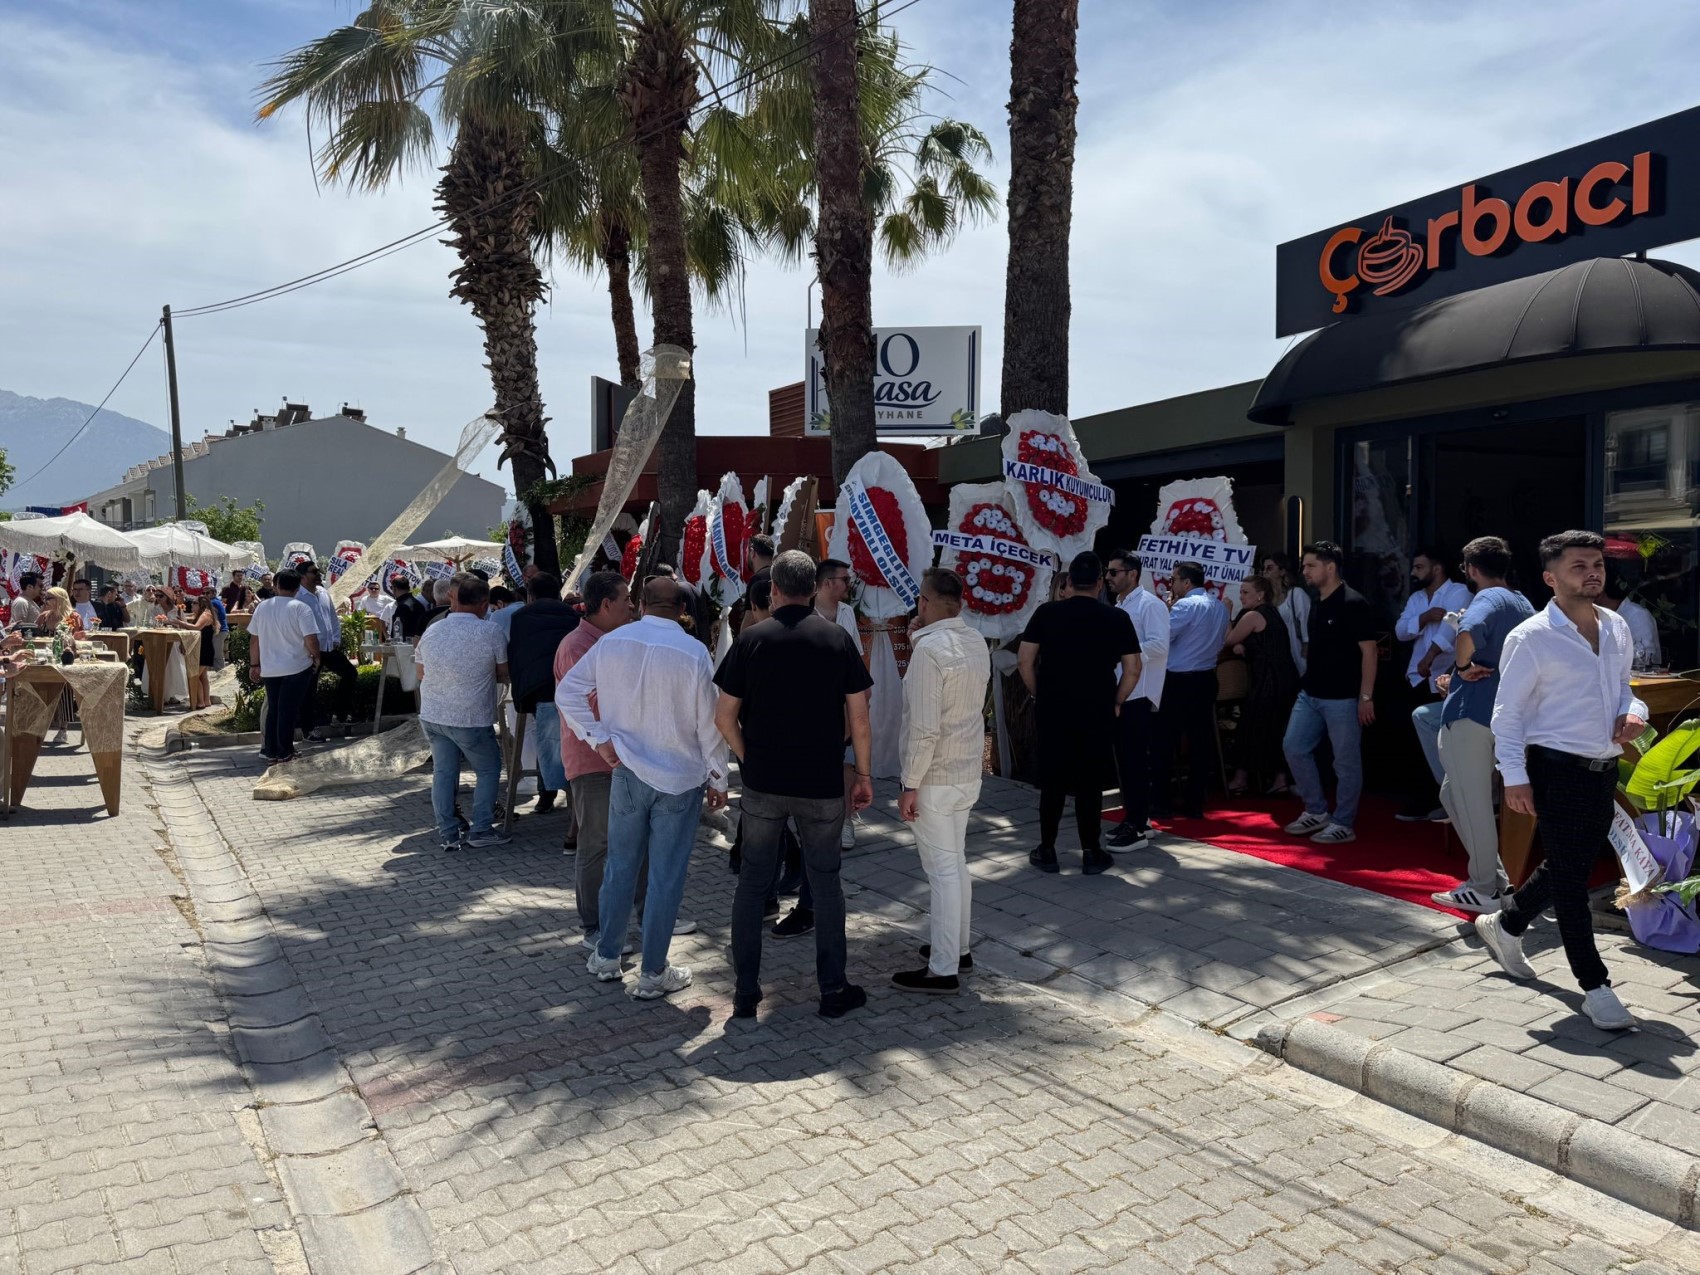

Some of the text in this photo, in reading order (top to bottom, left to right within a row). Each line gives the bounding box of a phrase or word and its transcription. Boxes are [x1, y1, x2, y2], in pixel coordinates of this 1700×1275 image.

[878, 410, 924, 420] YHANE
[1006, 461, 1113, 503] KARLIK KUYUMCULUK
[934, 532, 1052, 566] META İÇECEK
[1139, 538, 1251, 564] FETHİYE TV
[400, 569, 421, 586] BETON
[1140, 555, 1159, 569] URAT
[1202, 564, 1220, 578] DAT
[876, 556, 915, 608] OLSUN
[893, 643, 906, 651] 375
[1614, 811, 1655, 877] FATMA KAYA
